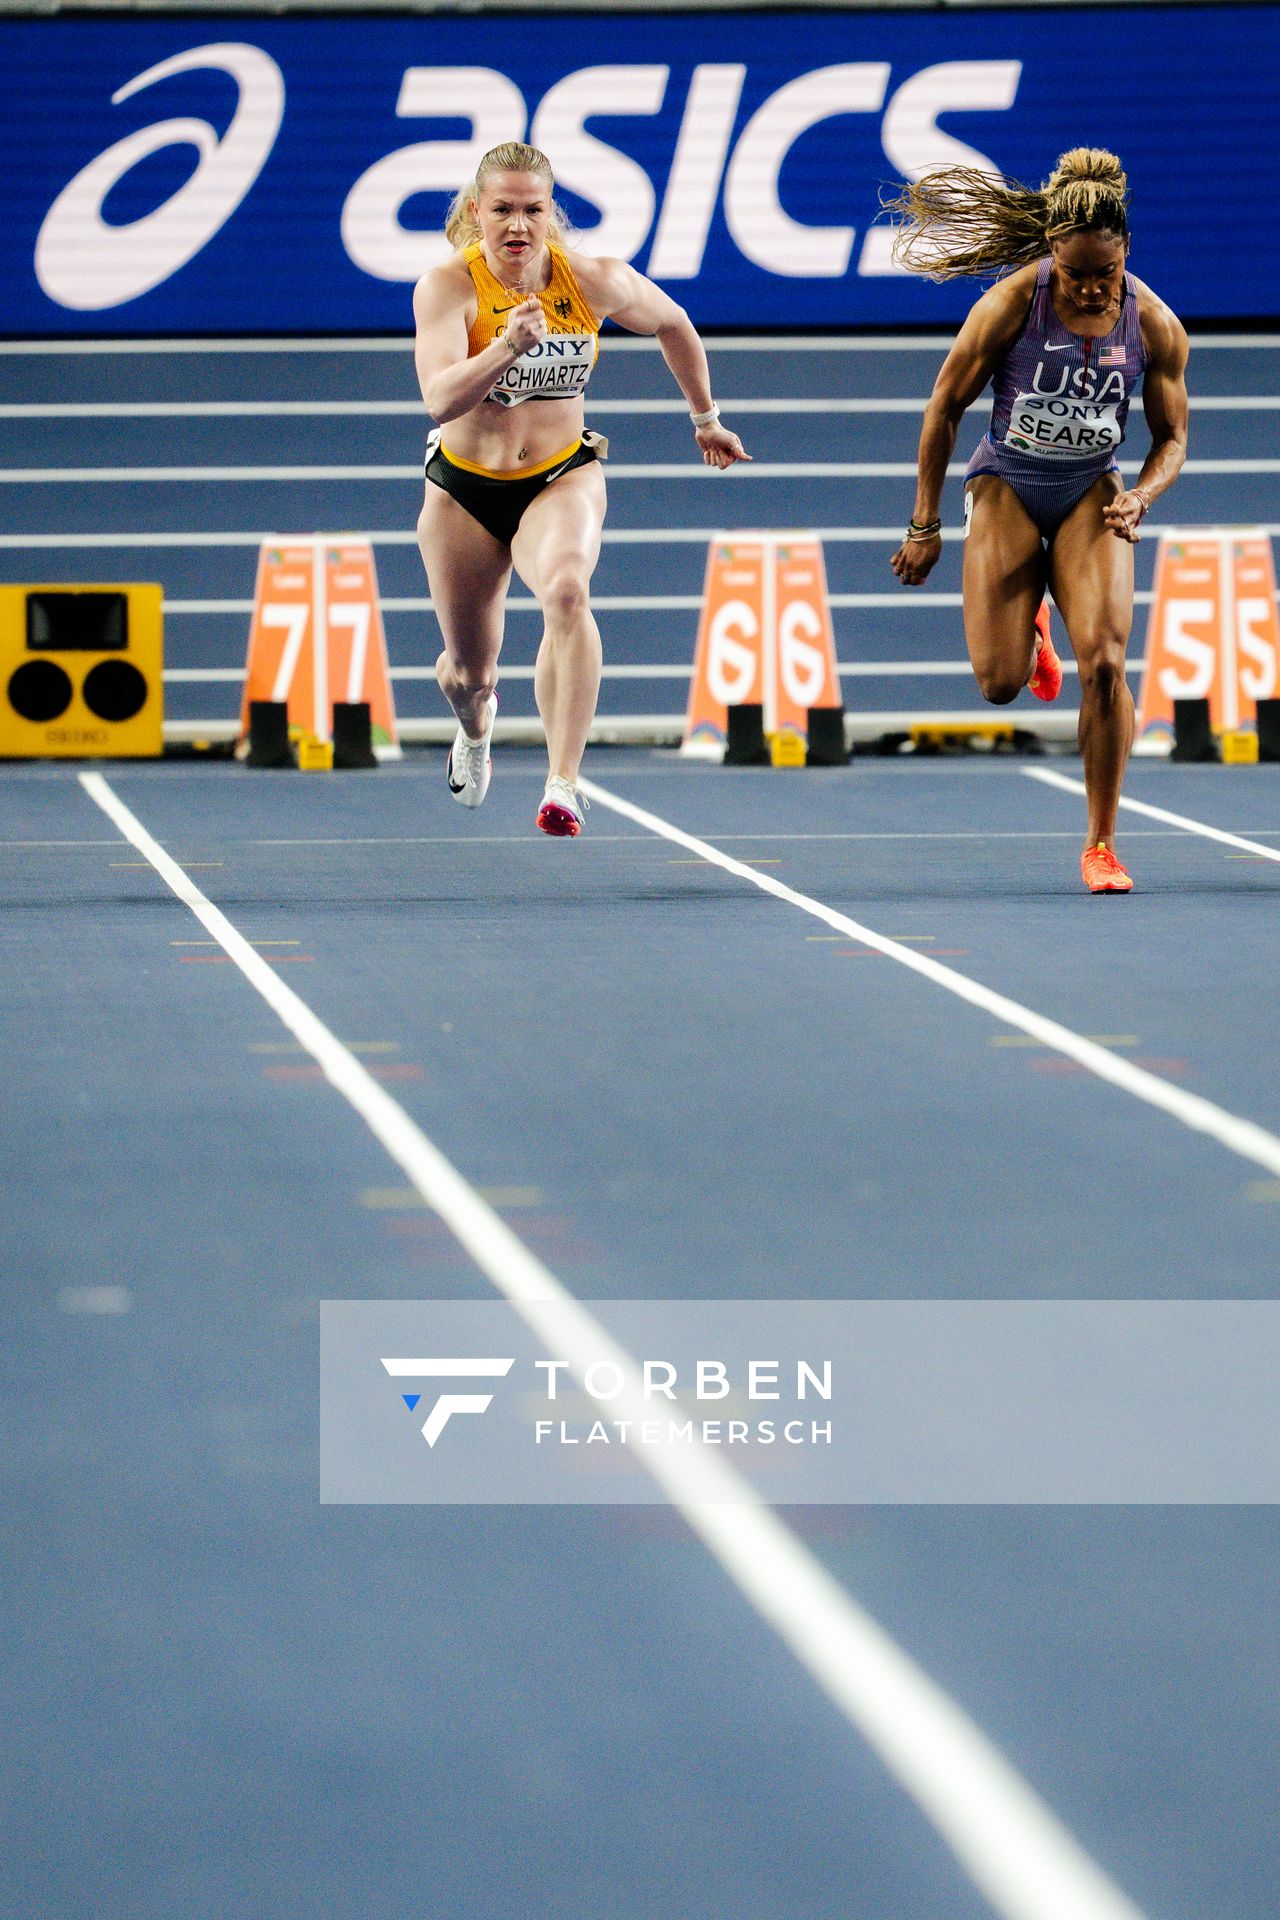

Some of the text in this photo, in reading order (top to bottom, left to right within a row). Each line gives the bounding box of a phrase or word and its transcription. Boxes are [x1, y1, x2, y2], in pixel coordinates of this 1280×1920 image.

[524, 340, 589, 358] ONY
[1032, 361, 1125, 402] USA
[1018, 414, 1113, 447] SEARS
[1025, 399, 1109, 420] SONY
[261, 603, 309, 702] 7
[328, 603, 371, 704] 7
[707, 600, 758, 706] 6
[779, 600, 825, 706] 6
[1158, 599, 1215, 700] 5
[1237, 599, 1276, 700] 5
